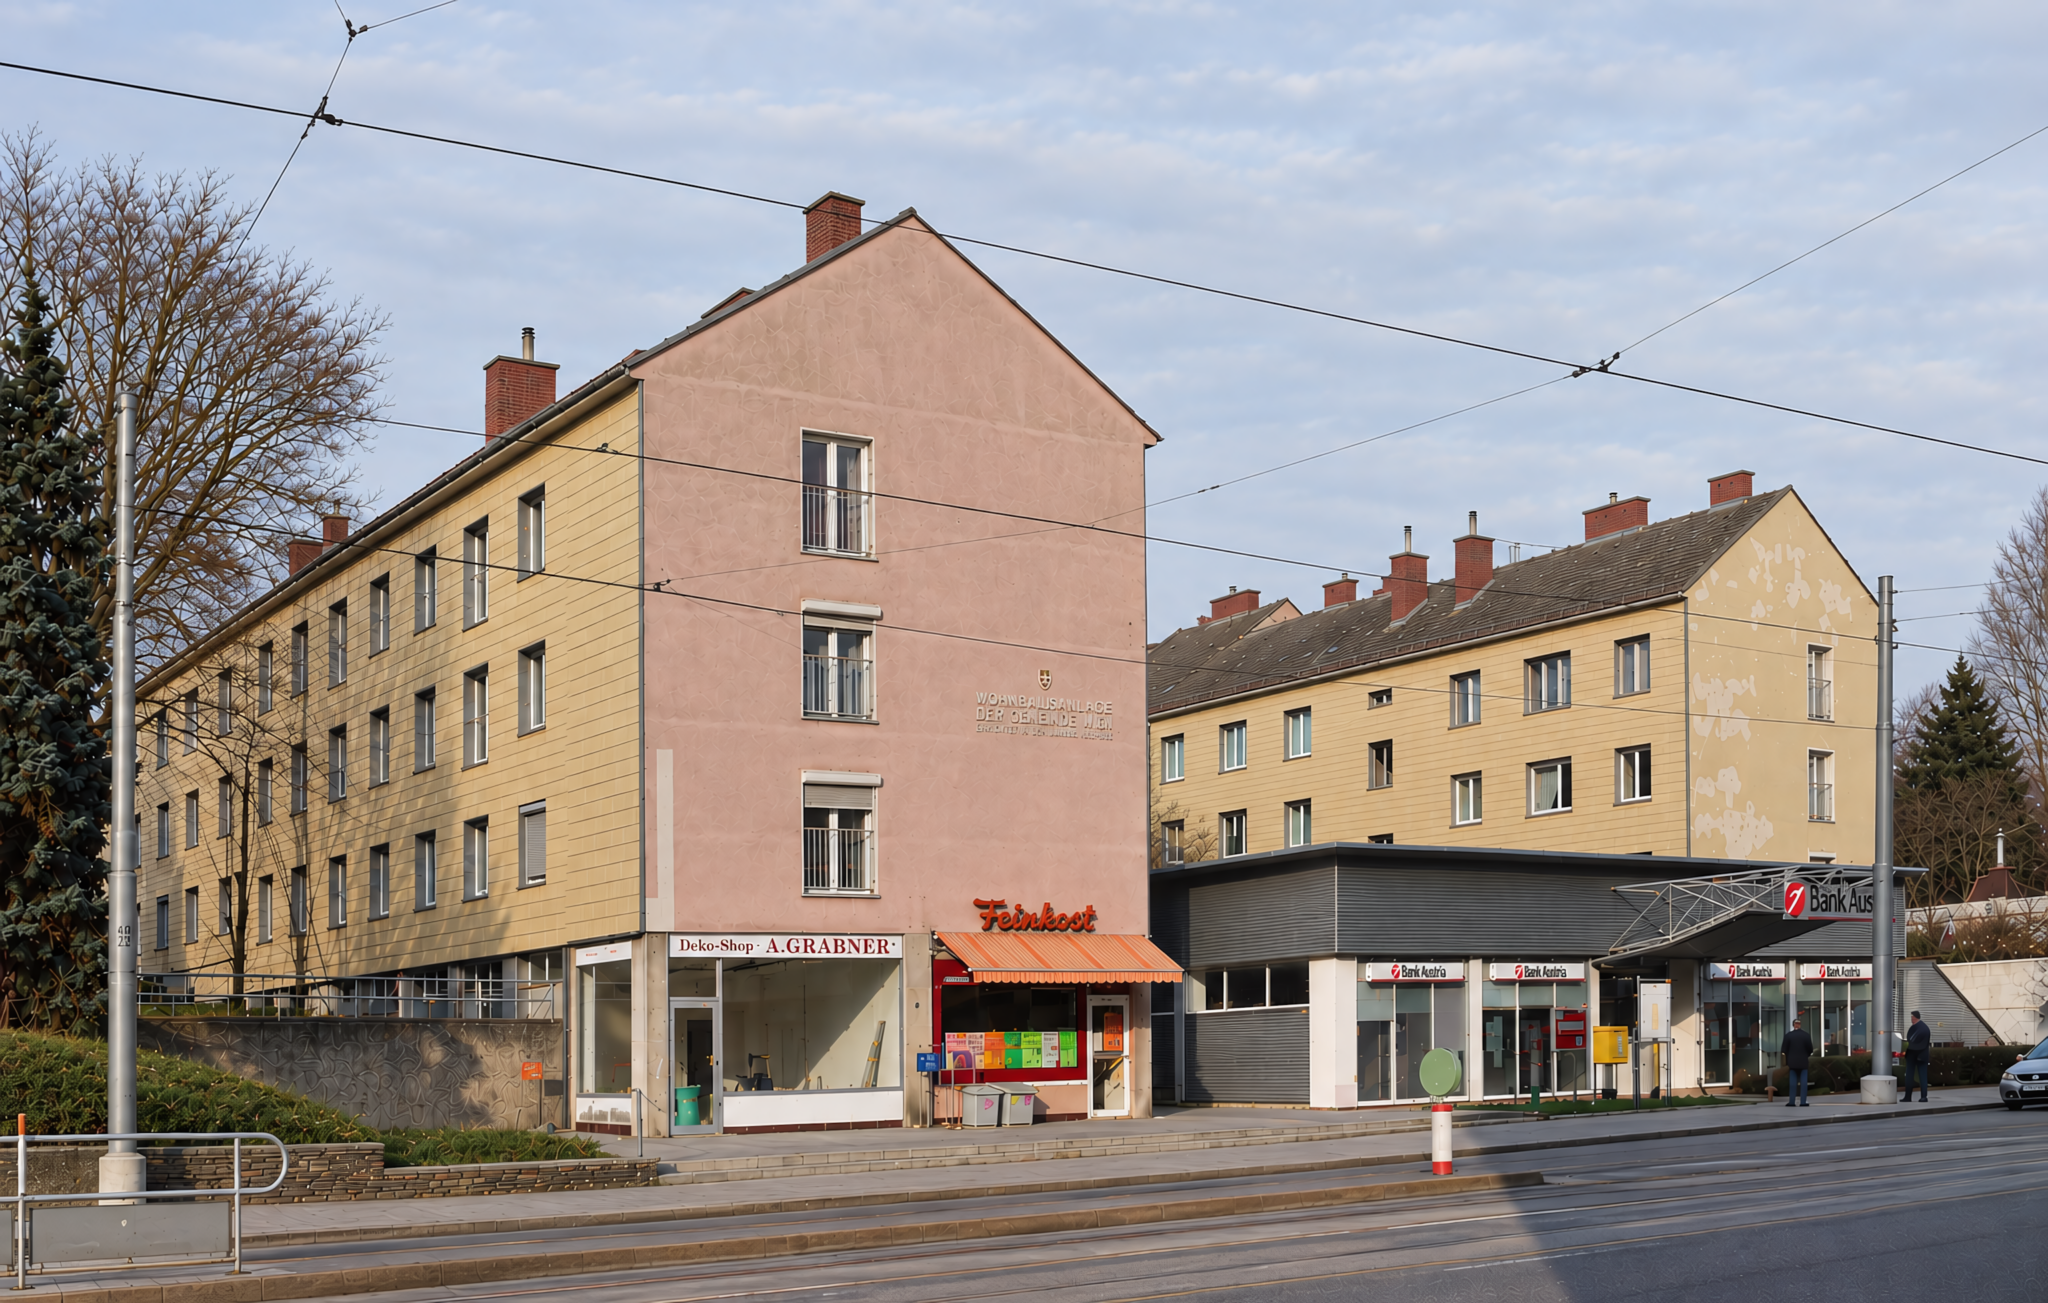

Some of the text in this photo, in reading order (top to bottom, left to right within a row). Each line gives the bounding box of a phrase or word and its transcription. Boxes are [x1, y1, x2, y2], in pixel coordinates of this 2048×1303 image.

[976, 706, 1004, 722] DER
[1810, 884, 1873, 913] Bank Aus
[973, 898, 1097, 932] Feinkost
[678, 938, 754, 955] Deko-Shop
